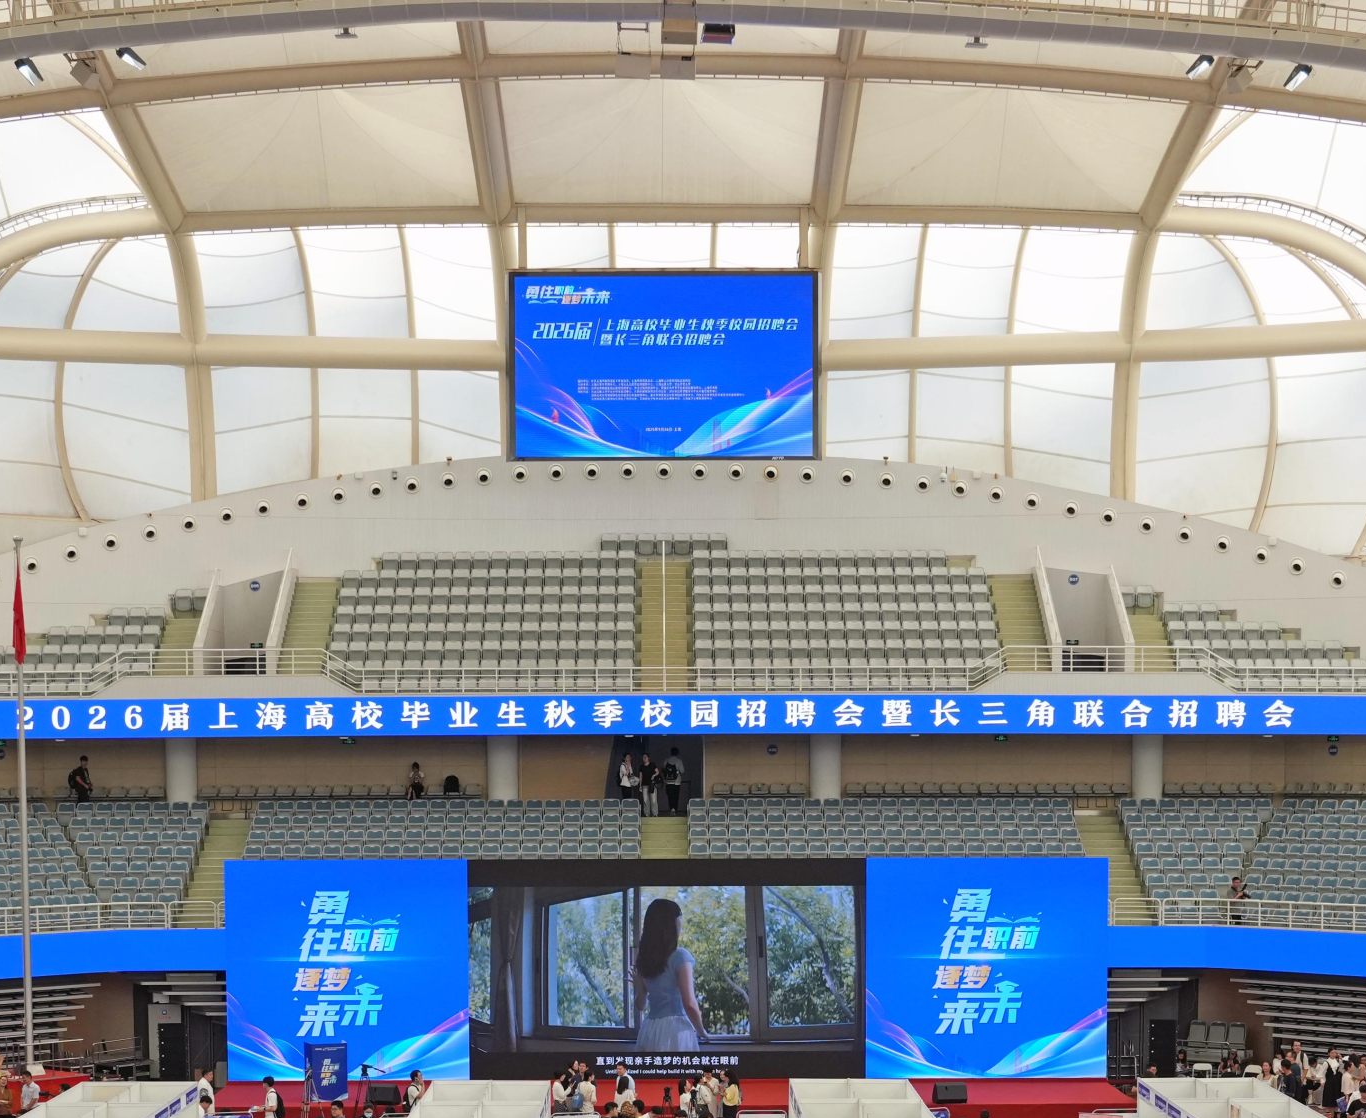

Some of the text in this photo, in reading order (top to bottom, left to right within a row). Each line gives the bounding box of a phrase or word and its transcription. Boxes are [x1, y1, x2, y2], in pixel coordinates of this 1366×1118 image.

[533, 321, 591, 340] 2026届
[602, 318, 799, 332] 上海高校毕业生秋季校园招聘会
[599, 333, 726, 346] 暨长三角联合招聘会
[15, 698, 1295, 731] 2026届上海高校毕业生秋季校园招聘会暨长三角联合招聘会
[596, 1056, 739, 1065] 直到发现亲手造梦的机会就在眼前
